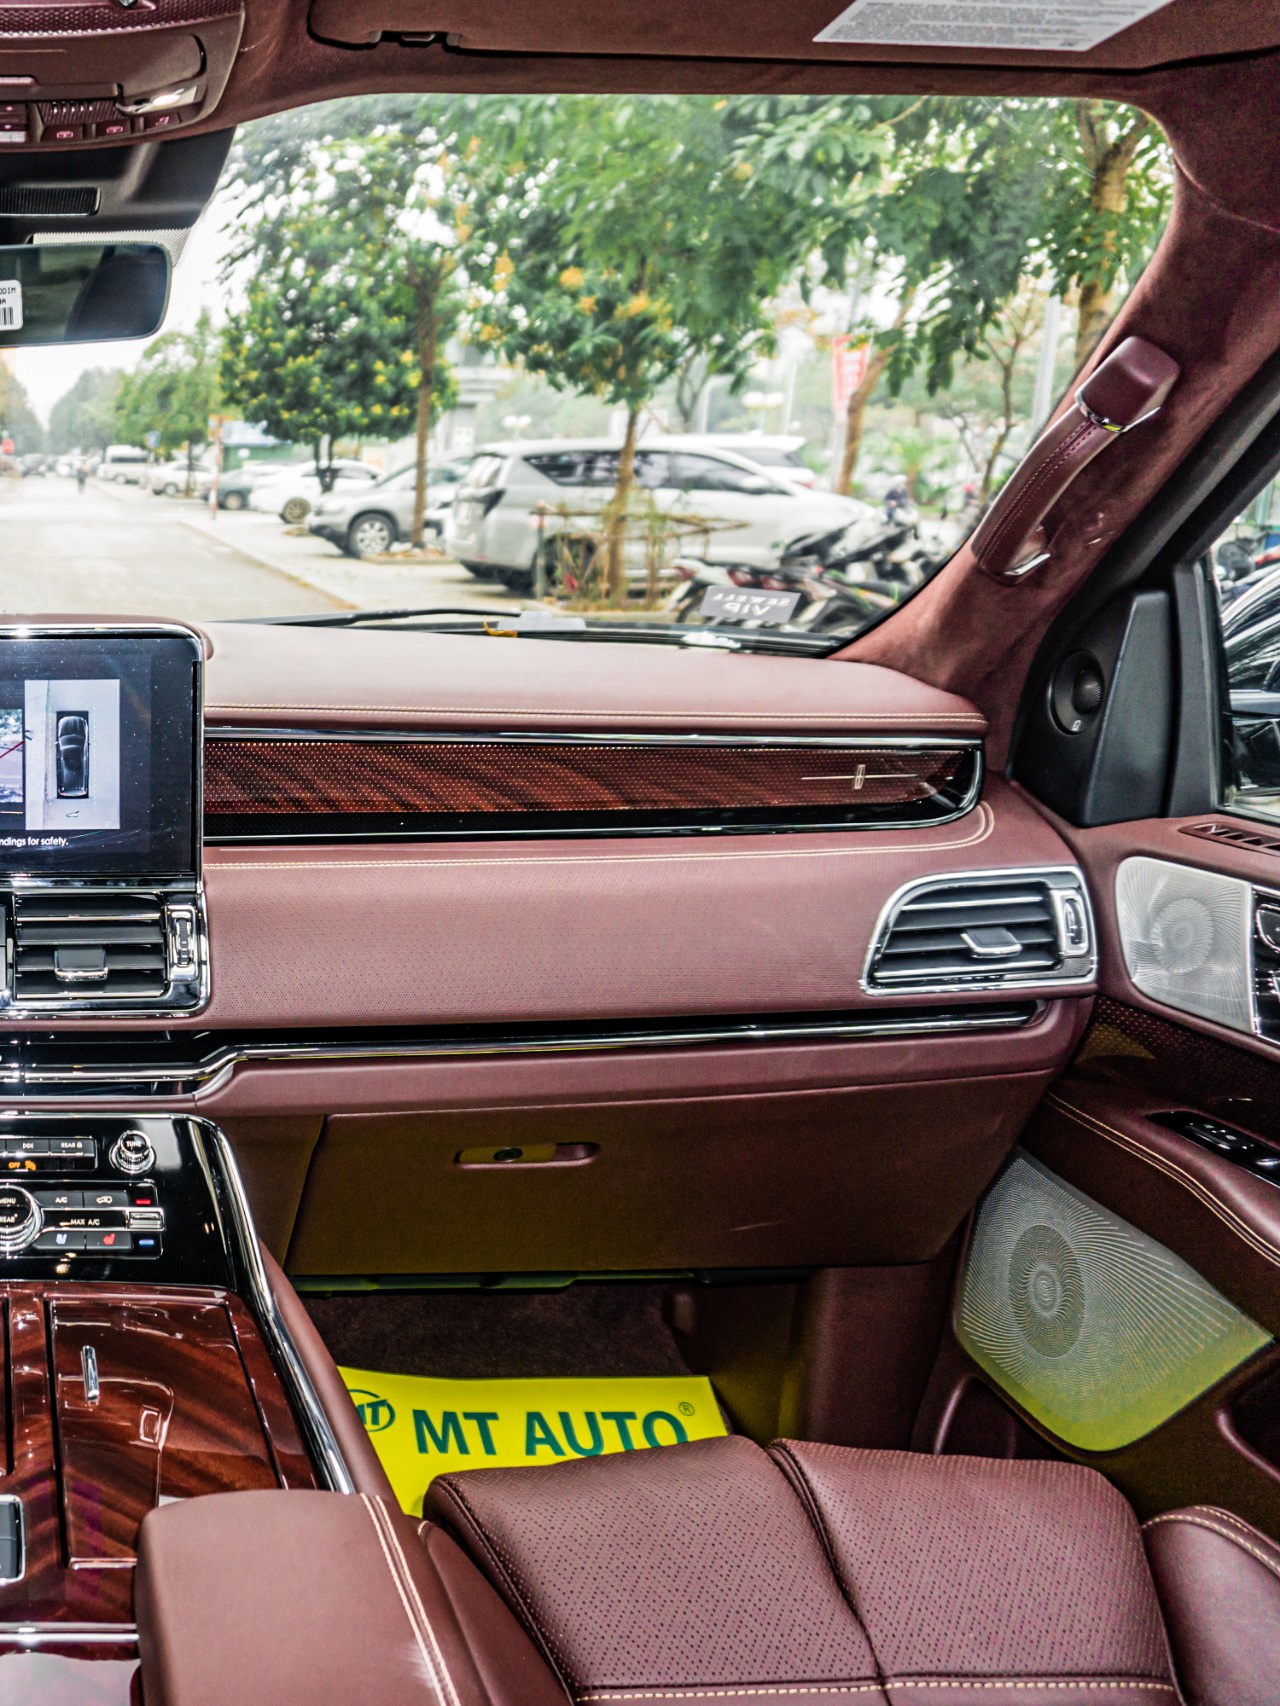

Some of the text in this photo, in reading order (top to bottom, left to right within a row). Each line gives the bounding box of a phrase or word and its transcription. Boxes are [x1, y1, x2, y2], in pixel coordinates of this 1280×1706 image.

[27, 836, 40, 846] for
[40, 836, 69, 847] safety.
[61, 1141, 76, 1149] REAR
[8, 1161, 21, 1169] OFF
[55, 1196, 67, 1204] A/C
[70, 1218, 101, 1226] MAX A/C
[412, 1408, 500, 1457] MT
